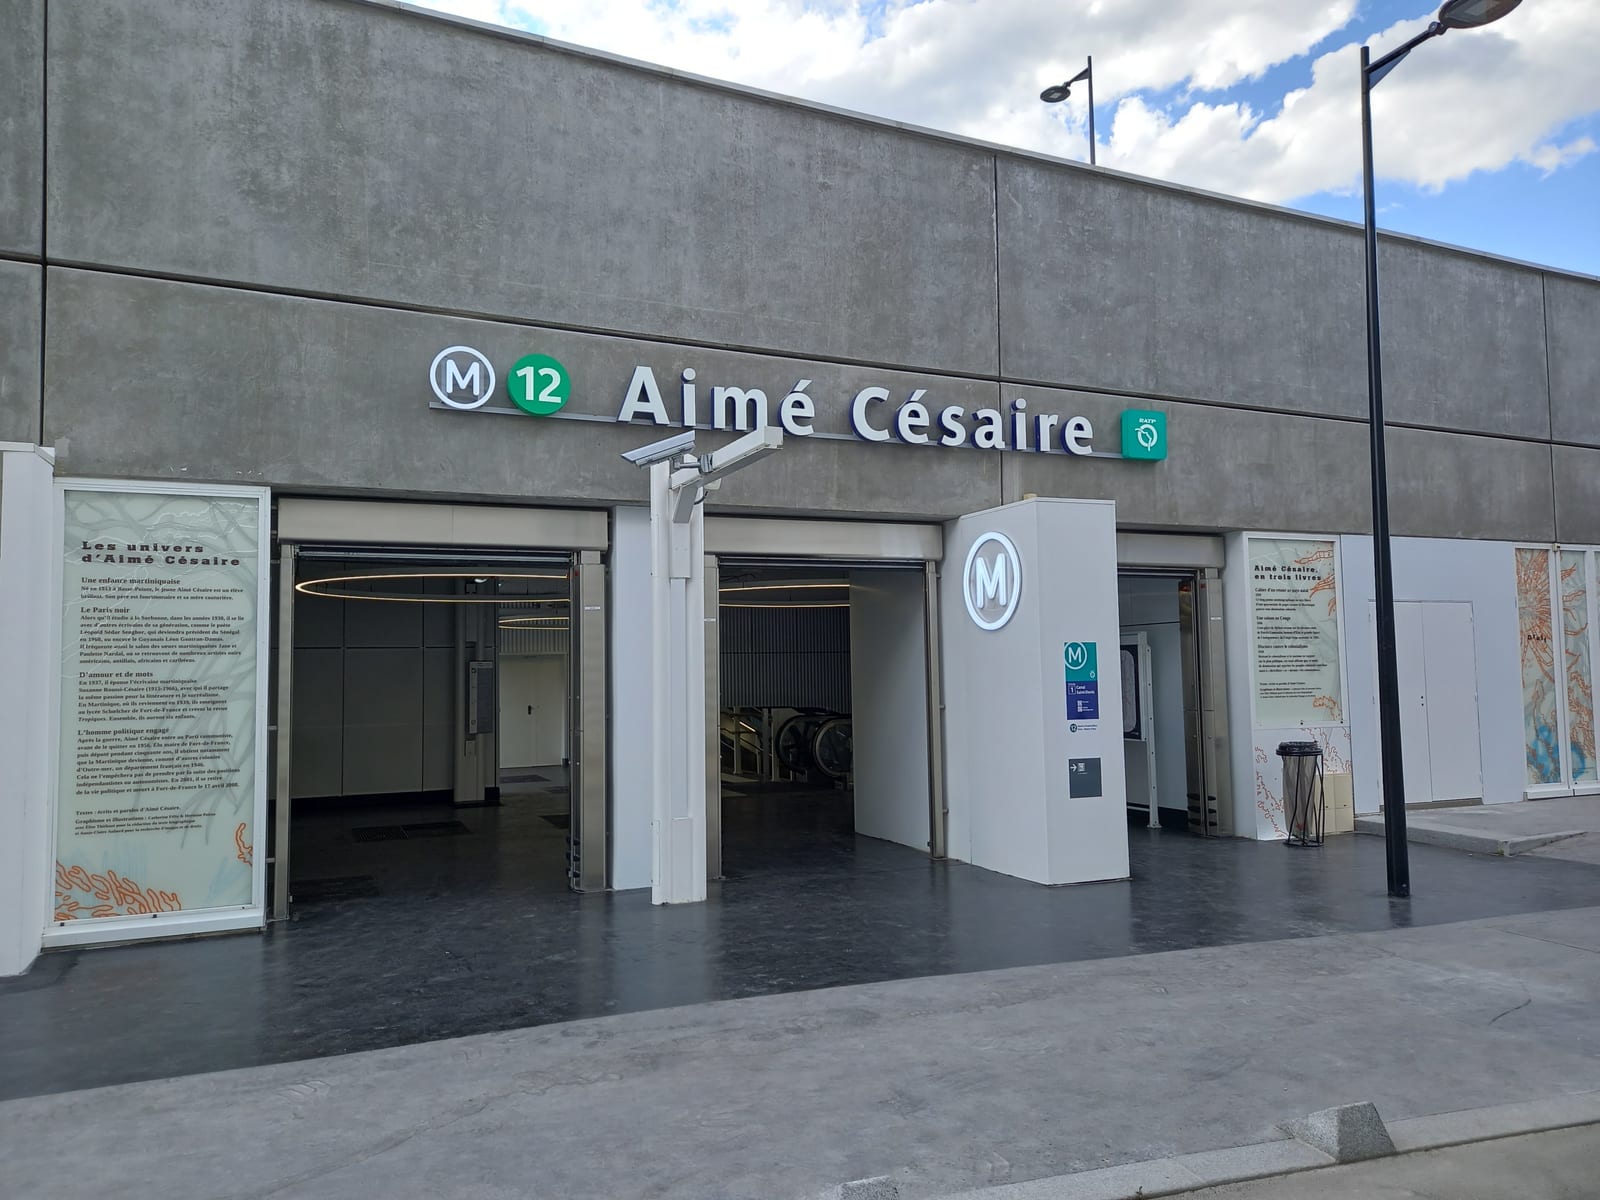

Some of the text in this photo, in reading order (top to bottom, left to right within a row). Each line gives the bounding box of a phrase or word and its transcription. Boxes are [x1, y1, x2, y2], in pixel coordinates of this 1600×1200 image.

[516, 366, 562, 404] 12
[617, 365, 1095, 456] Aimé Césaire
[82, 541, 204, 552] Les univers
[82, 554, 240, 566] d'Aimé Césaire
[129, 578, 180, 586] martiniquaise
